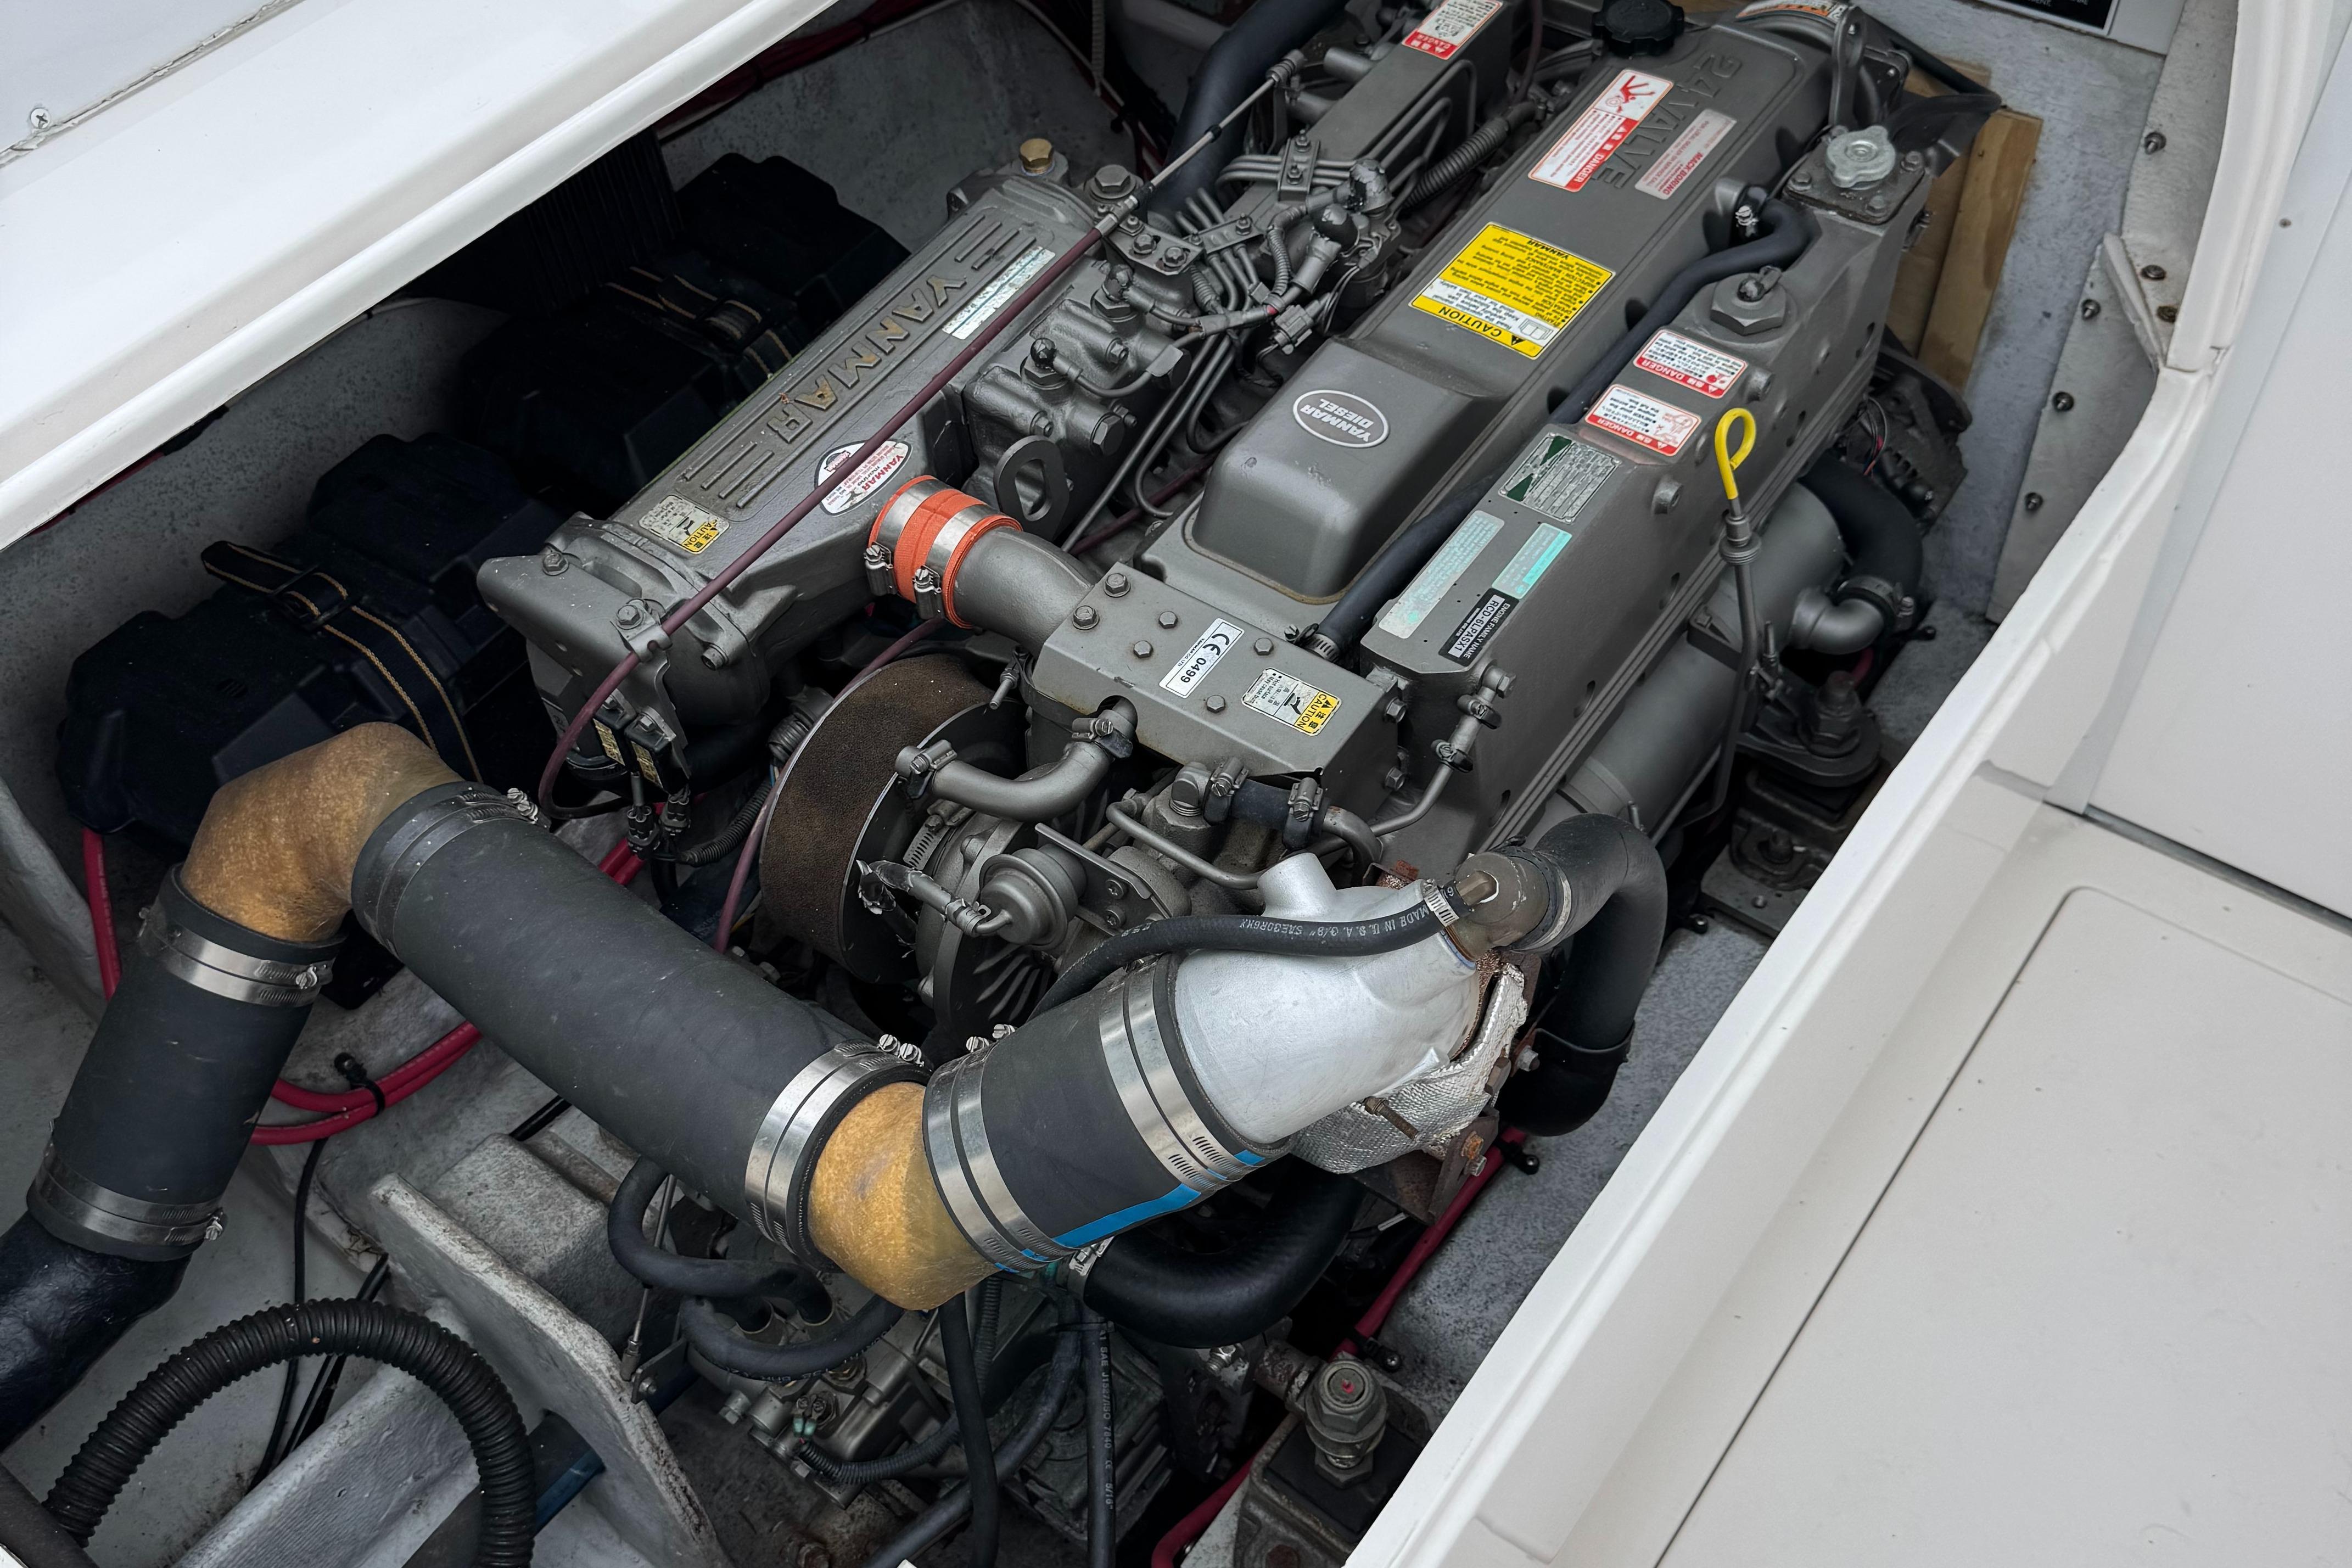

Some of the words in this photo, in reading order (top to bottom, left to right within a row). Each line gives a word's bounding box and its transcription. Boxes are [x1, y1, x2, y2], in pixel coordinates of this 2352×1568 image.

[1572, 153, 1605, 183] DANGER
[1682, 152, 1704, 172] MACK
[1661, 169, 1688, 195] BORING
[1526, 239, 1570, 260] YANMAR
[1436, 305, 1504, 338] CAUTION
[767, 276, 967, 444] YANMAR
[1639, 359, 1686, 380] DANGER
[1300, 405, 1371, 442] YANMAR
[1319, 399, 1374, 429] DIESEL
[1595, 417, 1636, 436] DANGER
[858, 465, 880, 486] marine
[861, 455, 904, 492] YANMAR
[1490, 602, 1511, 624] ENGINE
[1453, 599, 1499, 652] RCD-6LPASX1
[1475, 621, 1496, 643] FAMILY
[1188, 637, 1205, 654] YANMAR
[1462, 641, 1480, 659] NAME
[1178, 656, 1208, 684] 0499
[1293, 693, 1331, 729] CAUTION
[1385, 919, 1396, 932] IN
[1399, 904, 1429, 927] MADE
